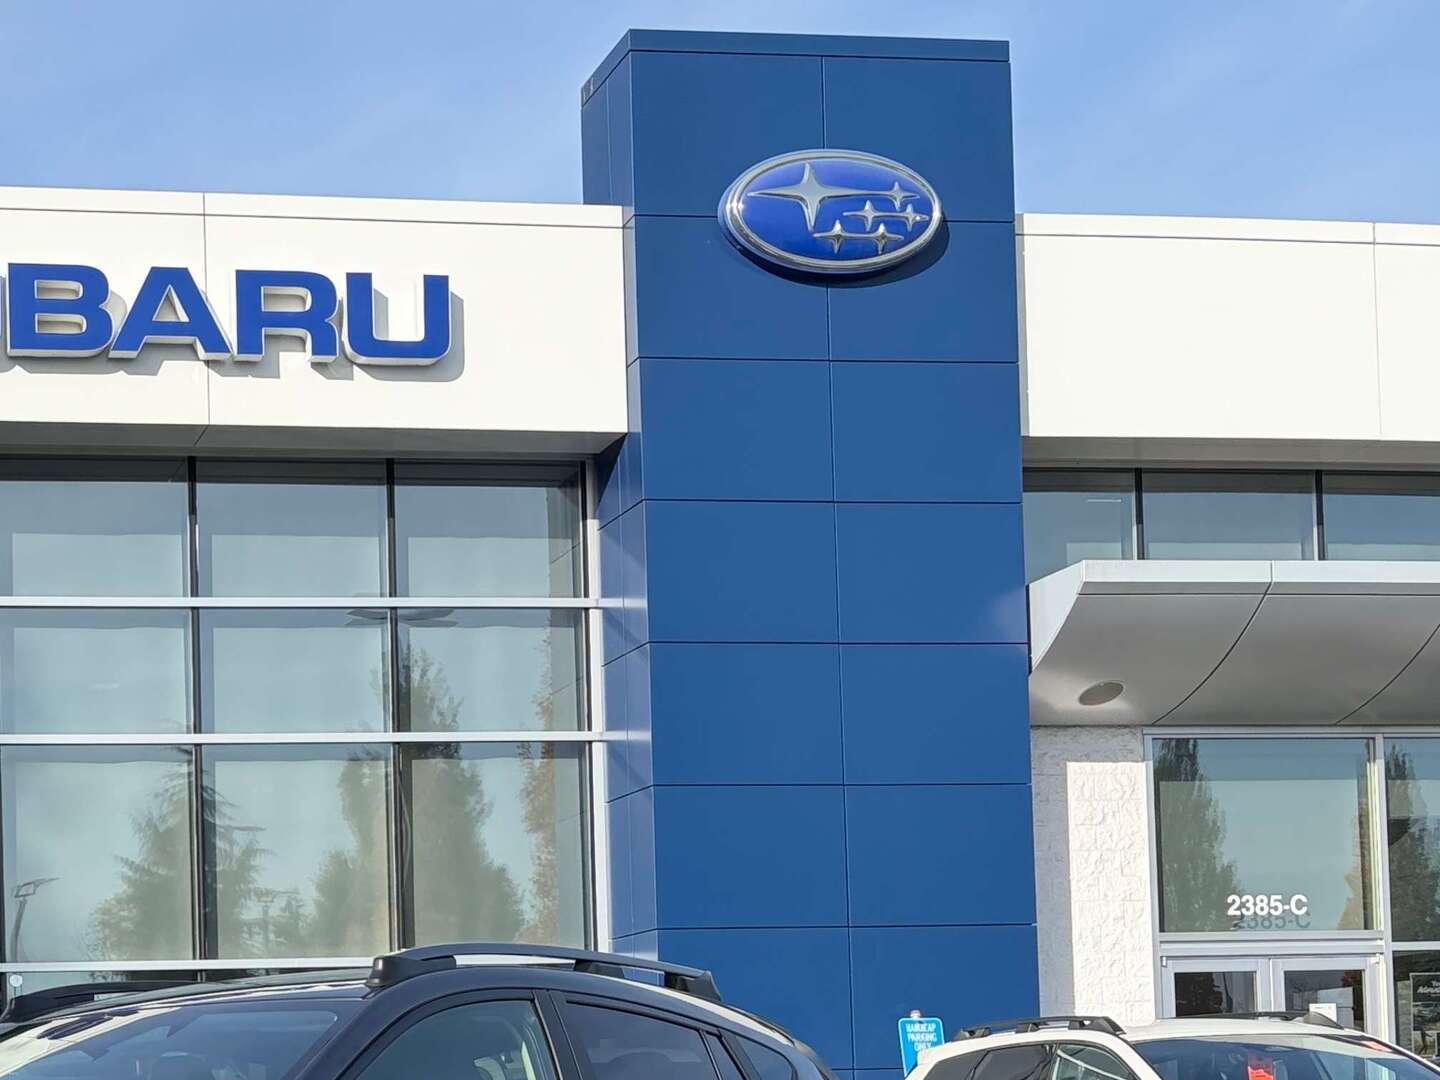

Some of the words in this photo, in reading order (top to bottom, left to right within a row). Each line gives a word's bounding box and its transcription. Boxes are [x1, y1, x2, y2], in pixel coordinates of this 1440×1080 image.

[1226, 894, 1308, 916] 2385-C
[905, 1023, 936, 1032] HANDICAP
[907, 1032, 938, 1042] PARKING
[913, 1042, 933, 1051] ONLY
